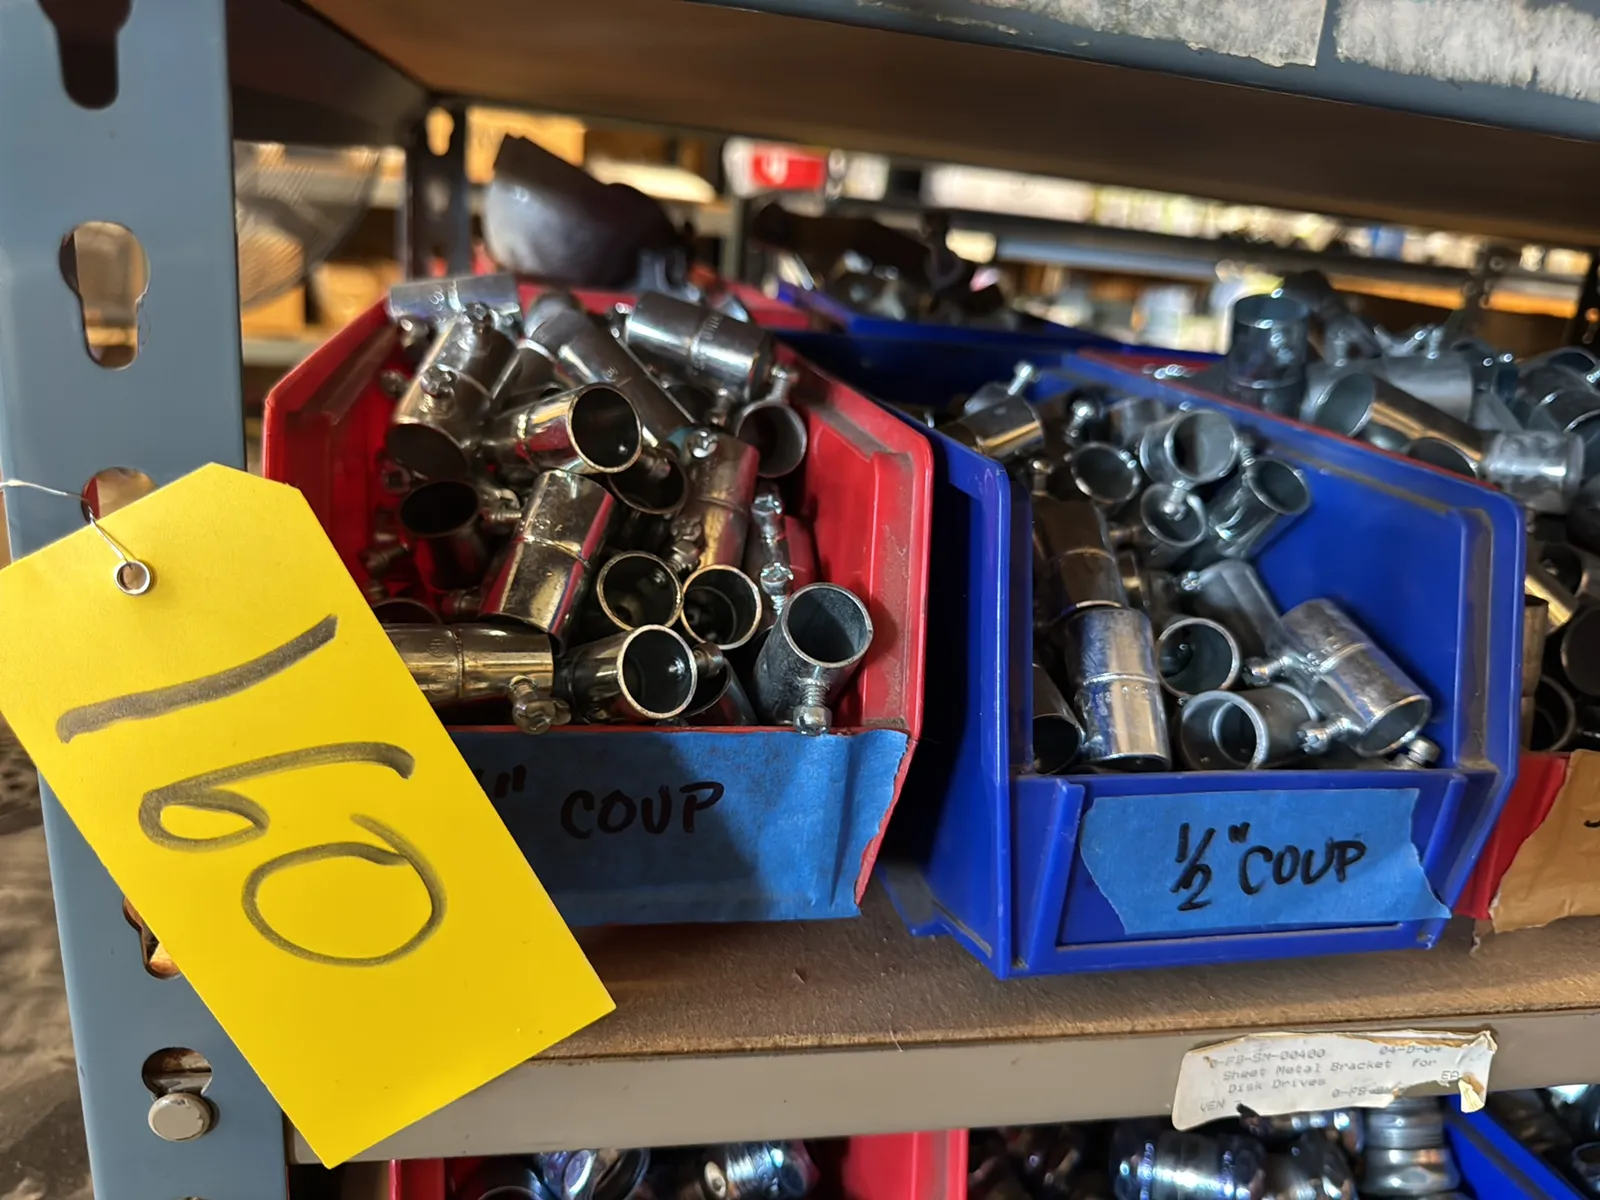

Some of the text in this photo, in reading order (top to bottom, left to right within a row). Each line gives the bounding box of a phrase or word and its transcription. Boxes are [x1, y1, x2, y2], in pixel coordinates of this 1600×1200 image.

[56, 612, 447, 967] 160
[560, 781, 724, 839] COUP
[1238, 838, 1366, 896] COUP
[1222, 1057, 1437, 1082] Sheet Metal Bracket for
[1228, 1077, 1327, 1094] Disk Drives
[1199, 1098, 1226, 1113] VEN
